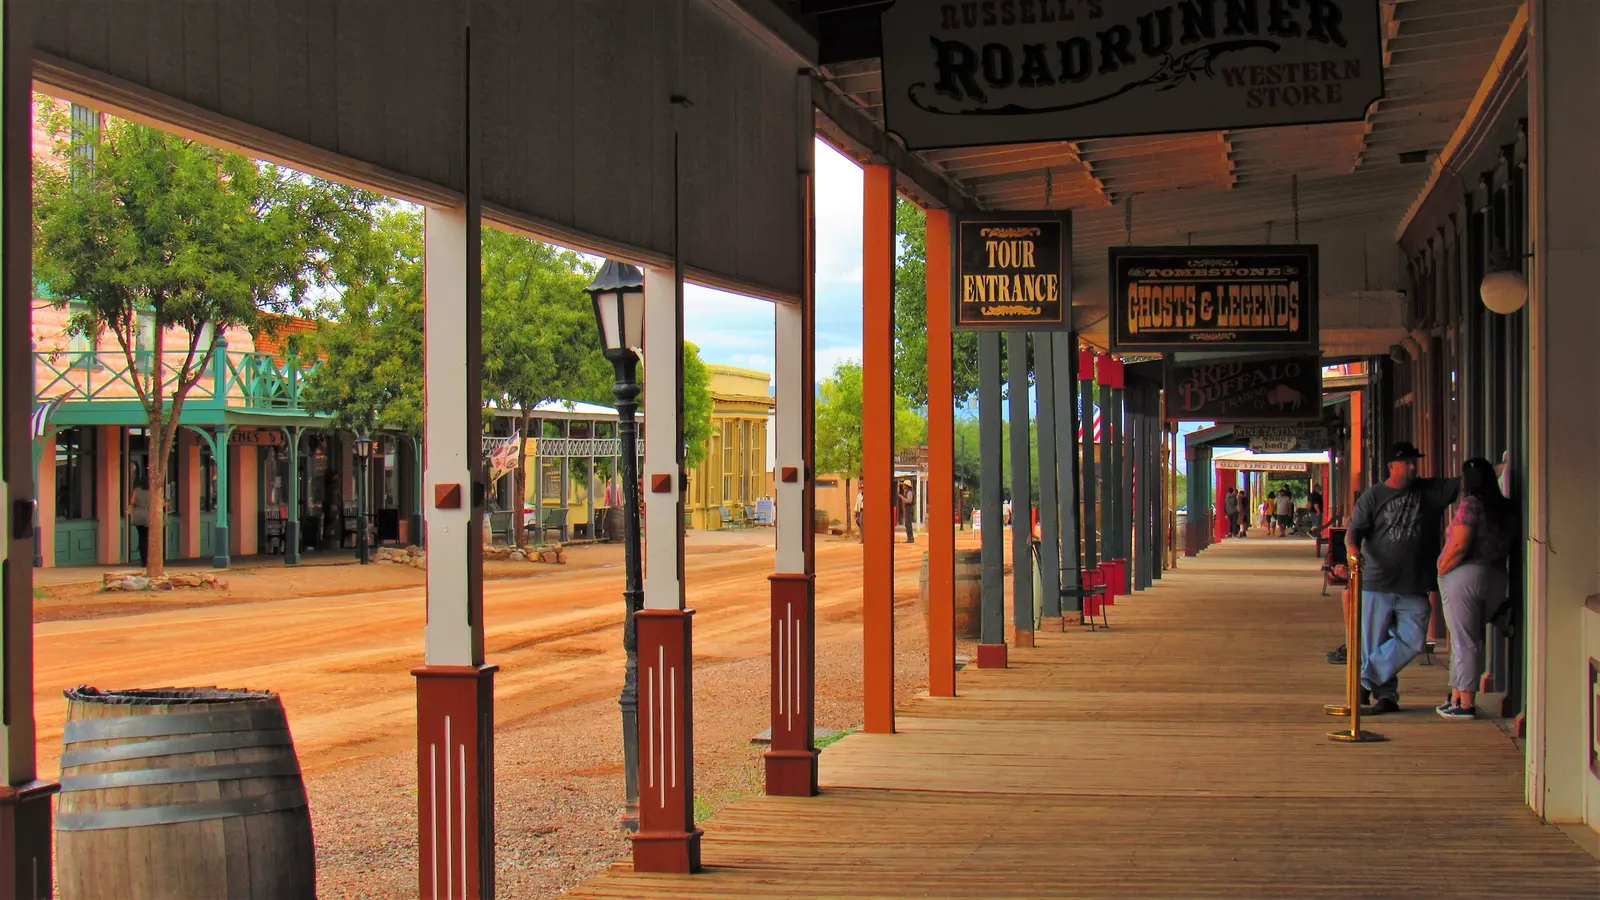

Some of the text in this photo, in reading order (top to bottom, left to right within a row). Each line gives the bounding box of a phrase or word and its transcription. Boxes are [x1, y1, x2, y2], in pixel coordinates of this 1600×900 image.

[929, 0, 1347, 103] ROADRUNNER
[1220, 59, 1361, 87] WESTERN
[1247, 83, 1342, 108] STORE
[986, 240, 1035, 268] TOUR
[1145, 268, 1281, 277] TOMBSTONE
[963, 274, 1058, 302] ENTRANCE
[1128, 281, 1299, 334] GHOSTS & LEGENDS
[1178, 362, 1301, 411] BUFFALO
[1234, 427, 1260, 436] WINE
[1262, 427, 1301, 436] TASTING
